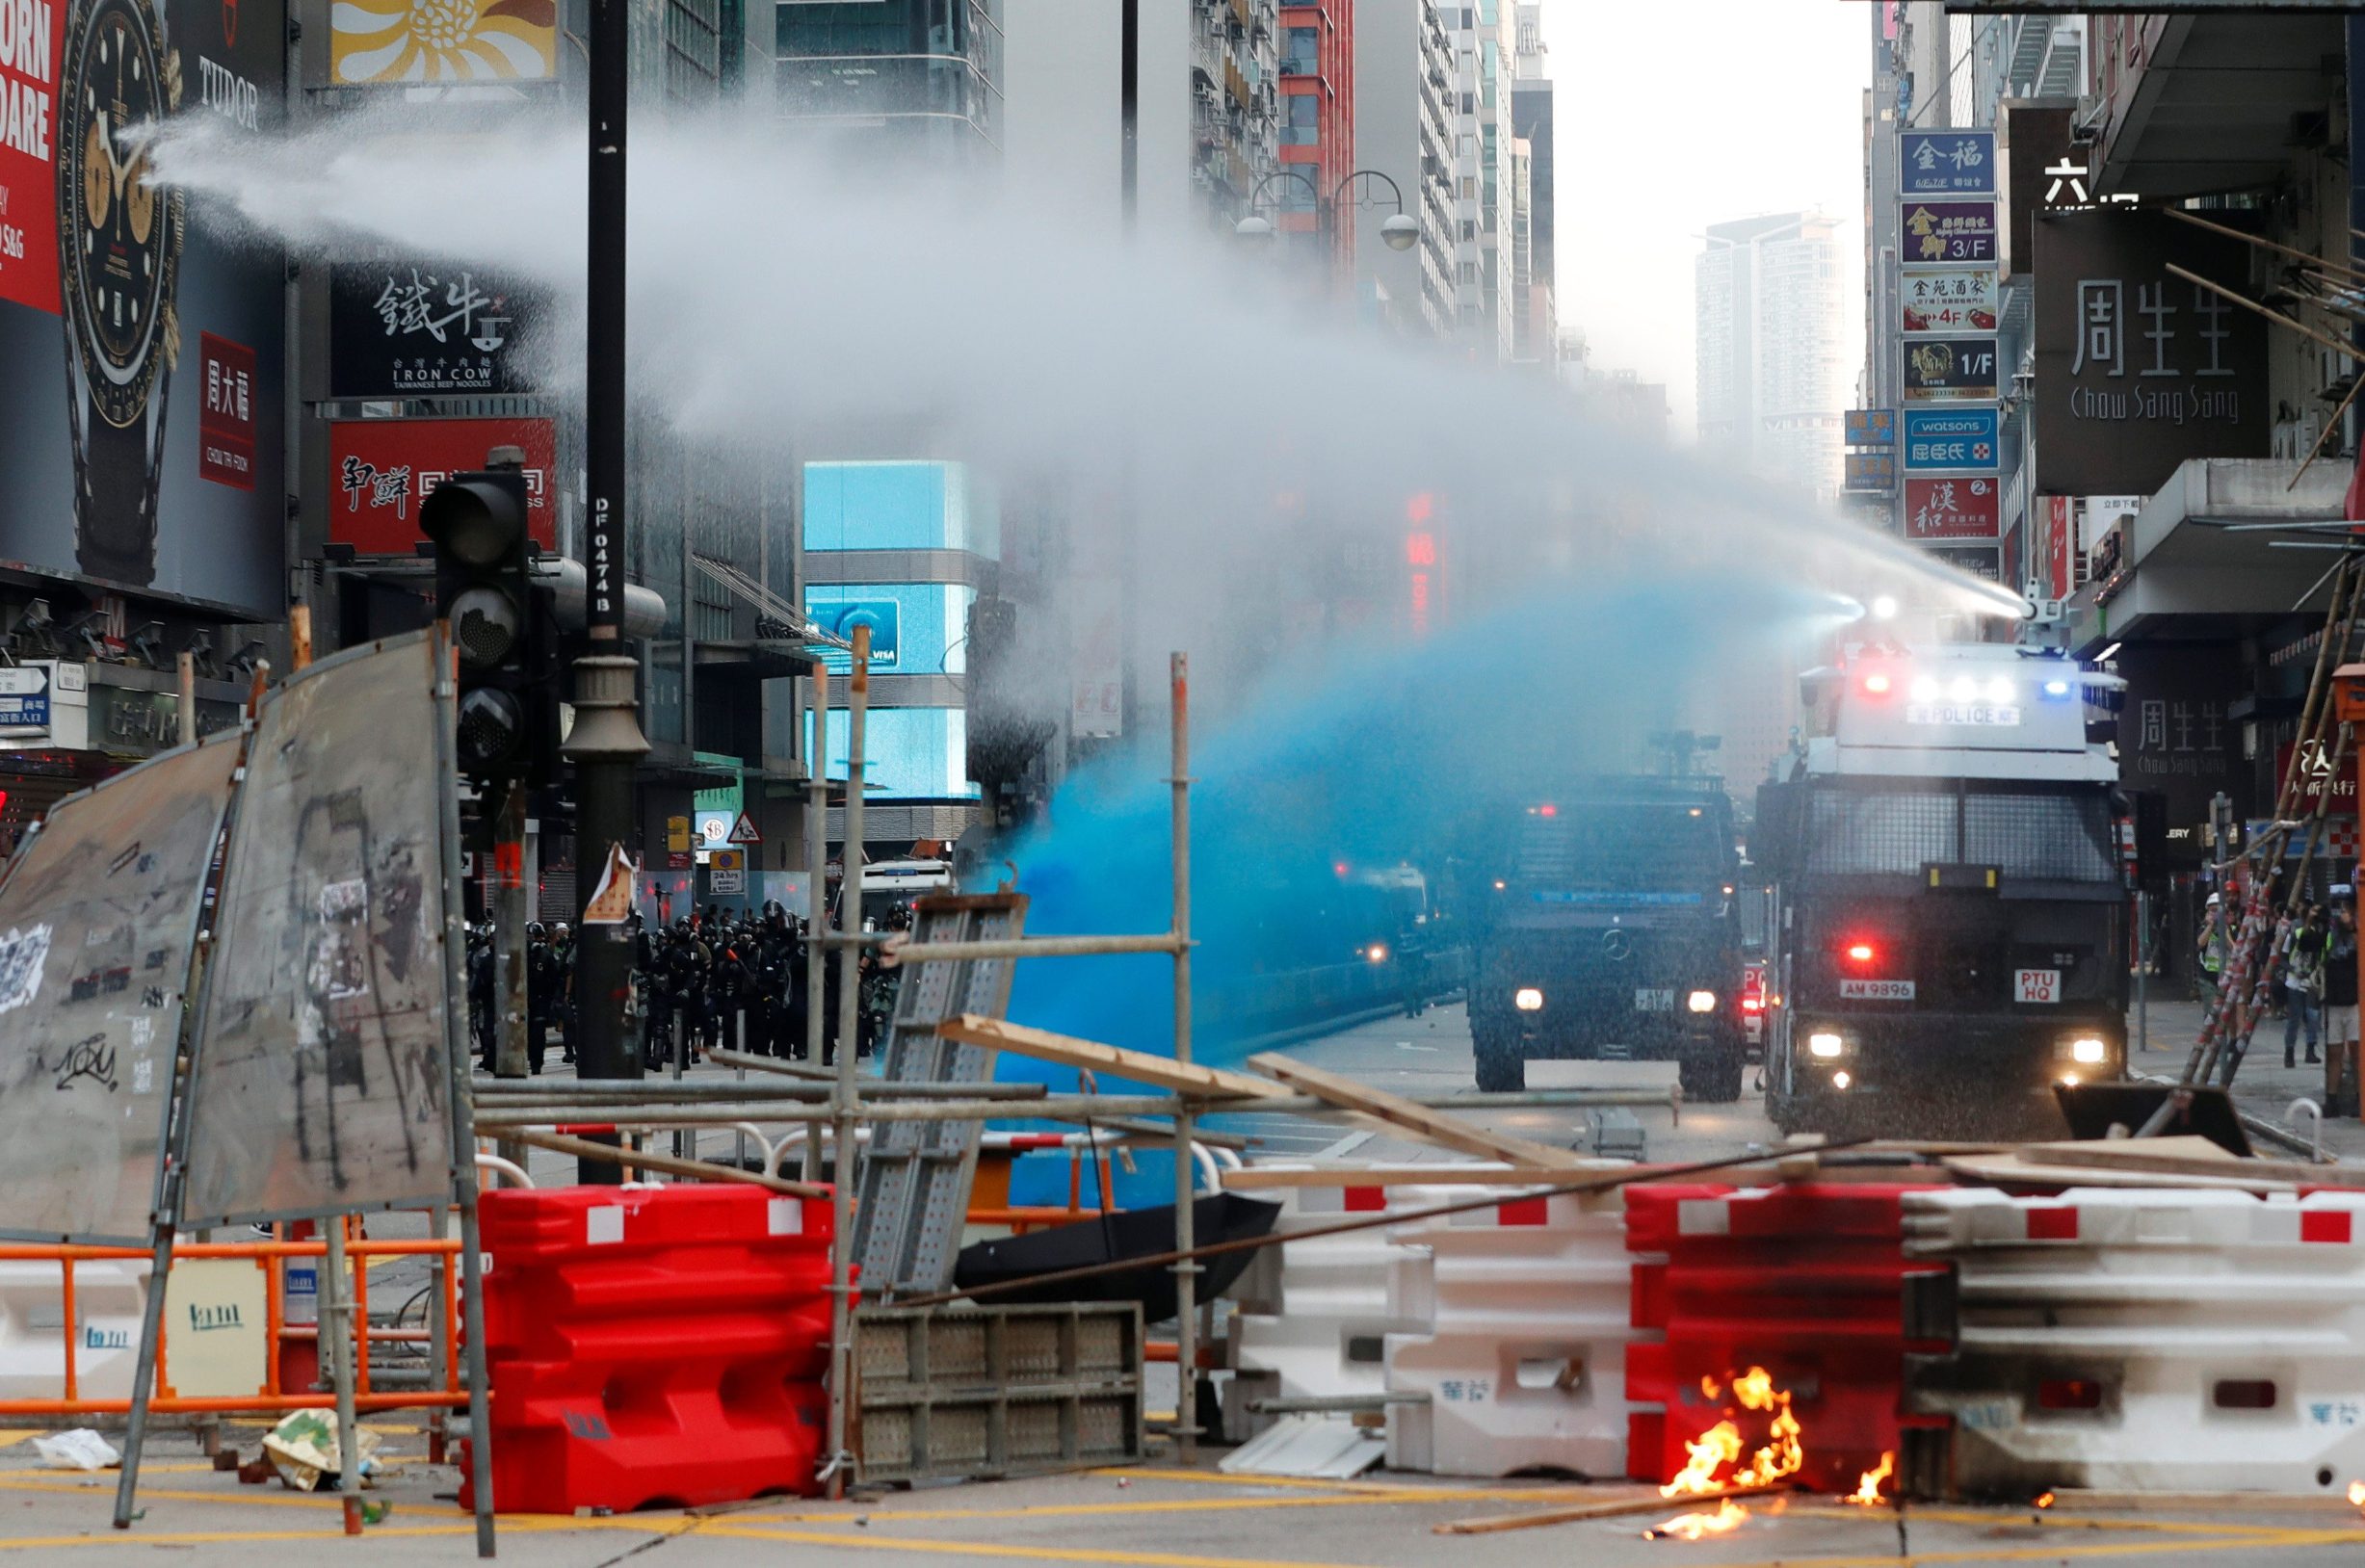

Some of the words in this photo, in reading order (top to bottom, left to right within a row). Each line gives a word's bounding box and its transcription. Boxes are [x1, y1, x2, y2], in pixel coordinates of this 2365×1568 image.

[198, 55, 258, 132] TUDOR
[1952, 239, 1987, 258] 3/F
[373, 268, 490, 343] 鐵牛
[1939, 308, 1961, 326] 4F
[2071, 279, 2236, 376] 周生生
[1961, 353, 1992, 375] 1/F
[393, 369, 441, 381] IRON
[450, 368, 492, 380] COW
[207, 358, 250, 421] 周大福
[2071, 386, 2126, 423] Chow
[2135, 384, 2184, 426] Sang
[2191, 384, 2239, 425] Sang
[1922, 421, 1981, 432] watsons
[1912, 443, 1965, 461] 屈臣氏
[873, 650, 895, 664] VISA
[1931, 708, 1994, 723] POLICE
[2138, 700, 2224, 751] 周生生
[2166, 828, 2191, 839] ERY
[2022, 973, 2055, 987] PTU
[1846, 984, 1866, 996] AM
[1869, 982, 1910, 997] 9896
[2025, 988, 2051, 1001] HQ
